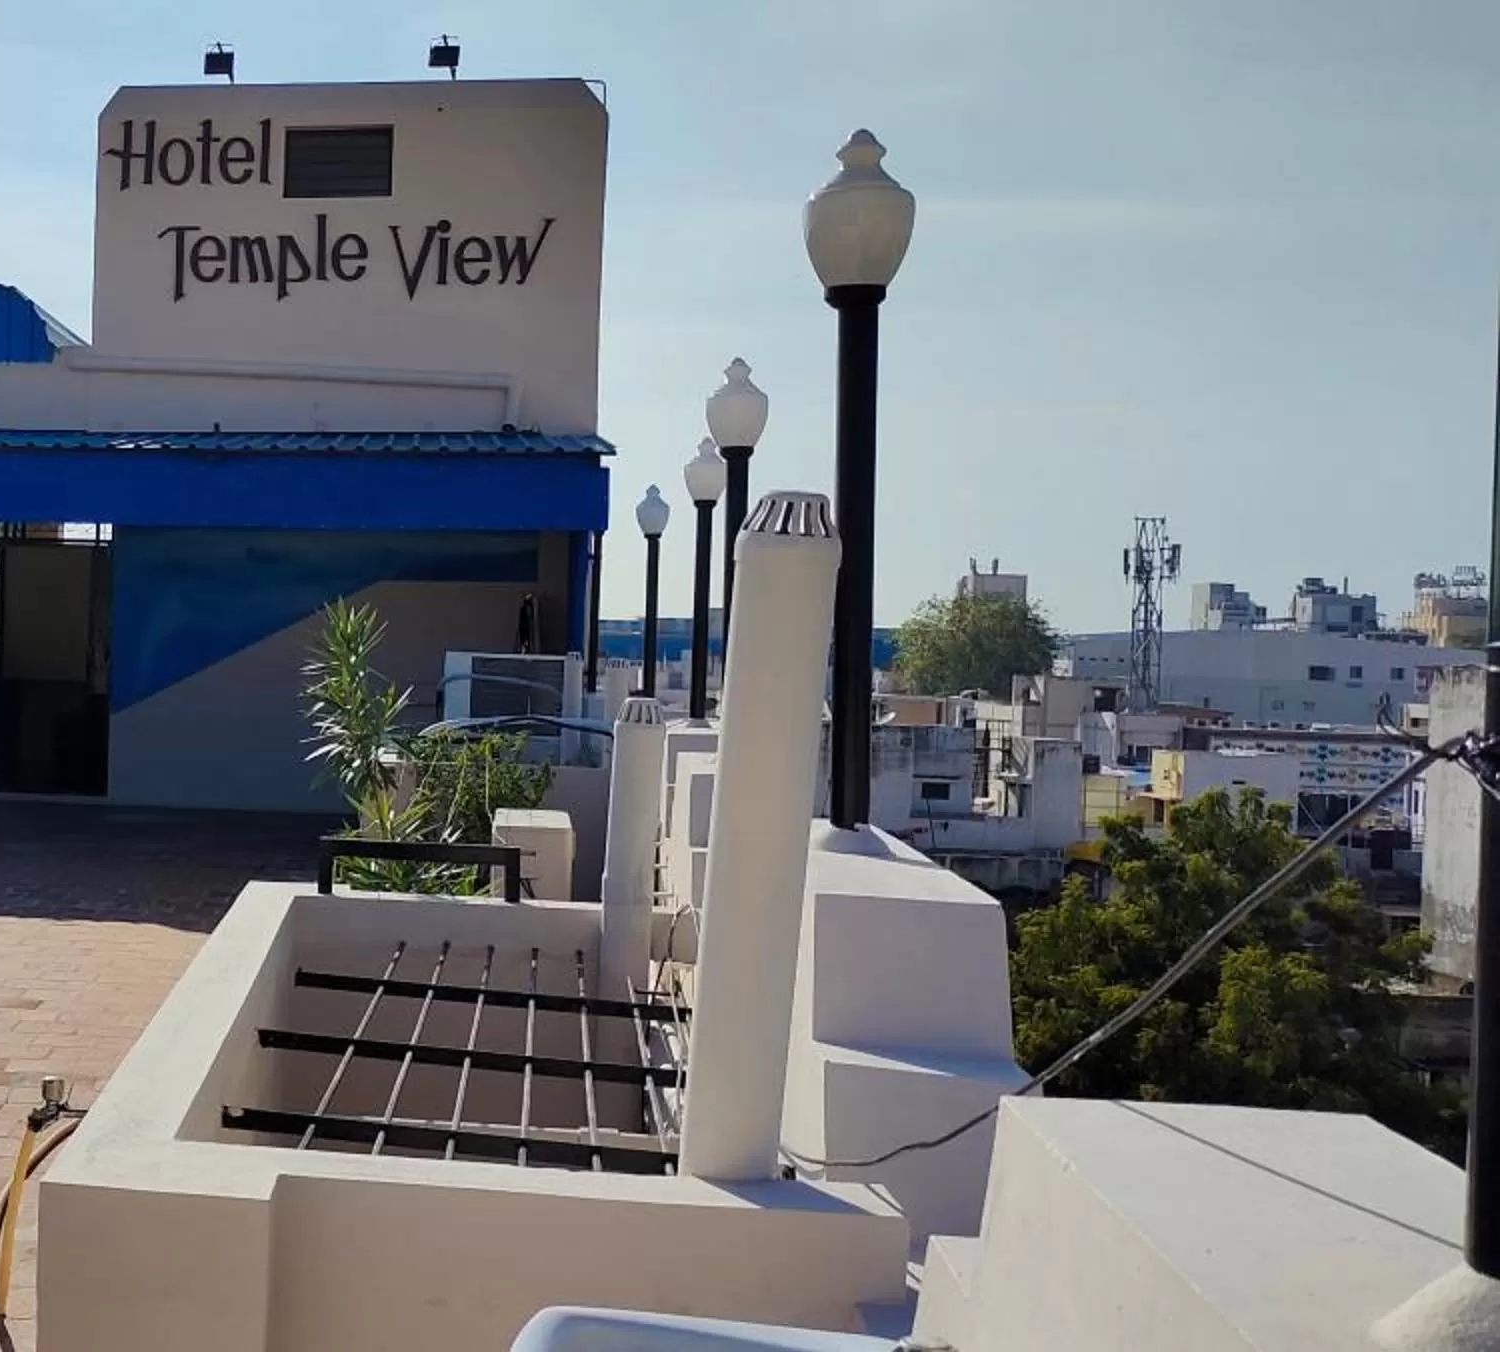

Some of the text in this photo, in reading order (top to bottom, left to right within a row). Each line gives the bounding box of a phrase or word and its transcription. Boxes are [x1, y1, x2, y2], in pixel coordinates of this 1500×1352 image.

[102, 119, 272, 191] Hotel
[158, 214, 556, 302] Temple View
